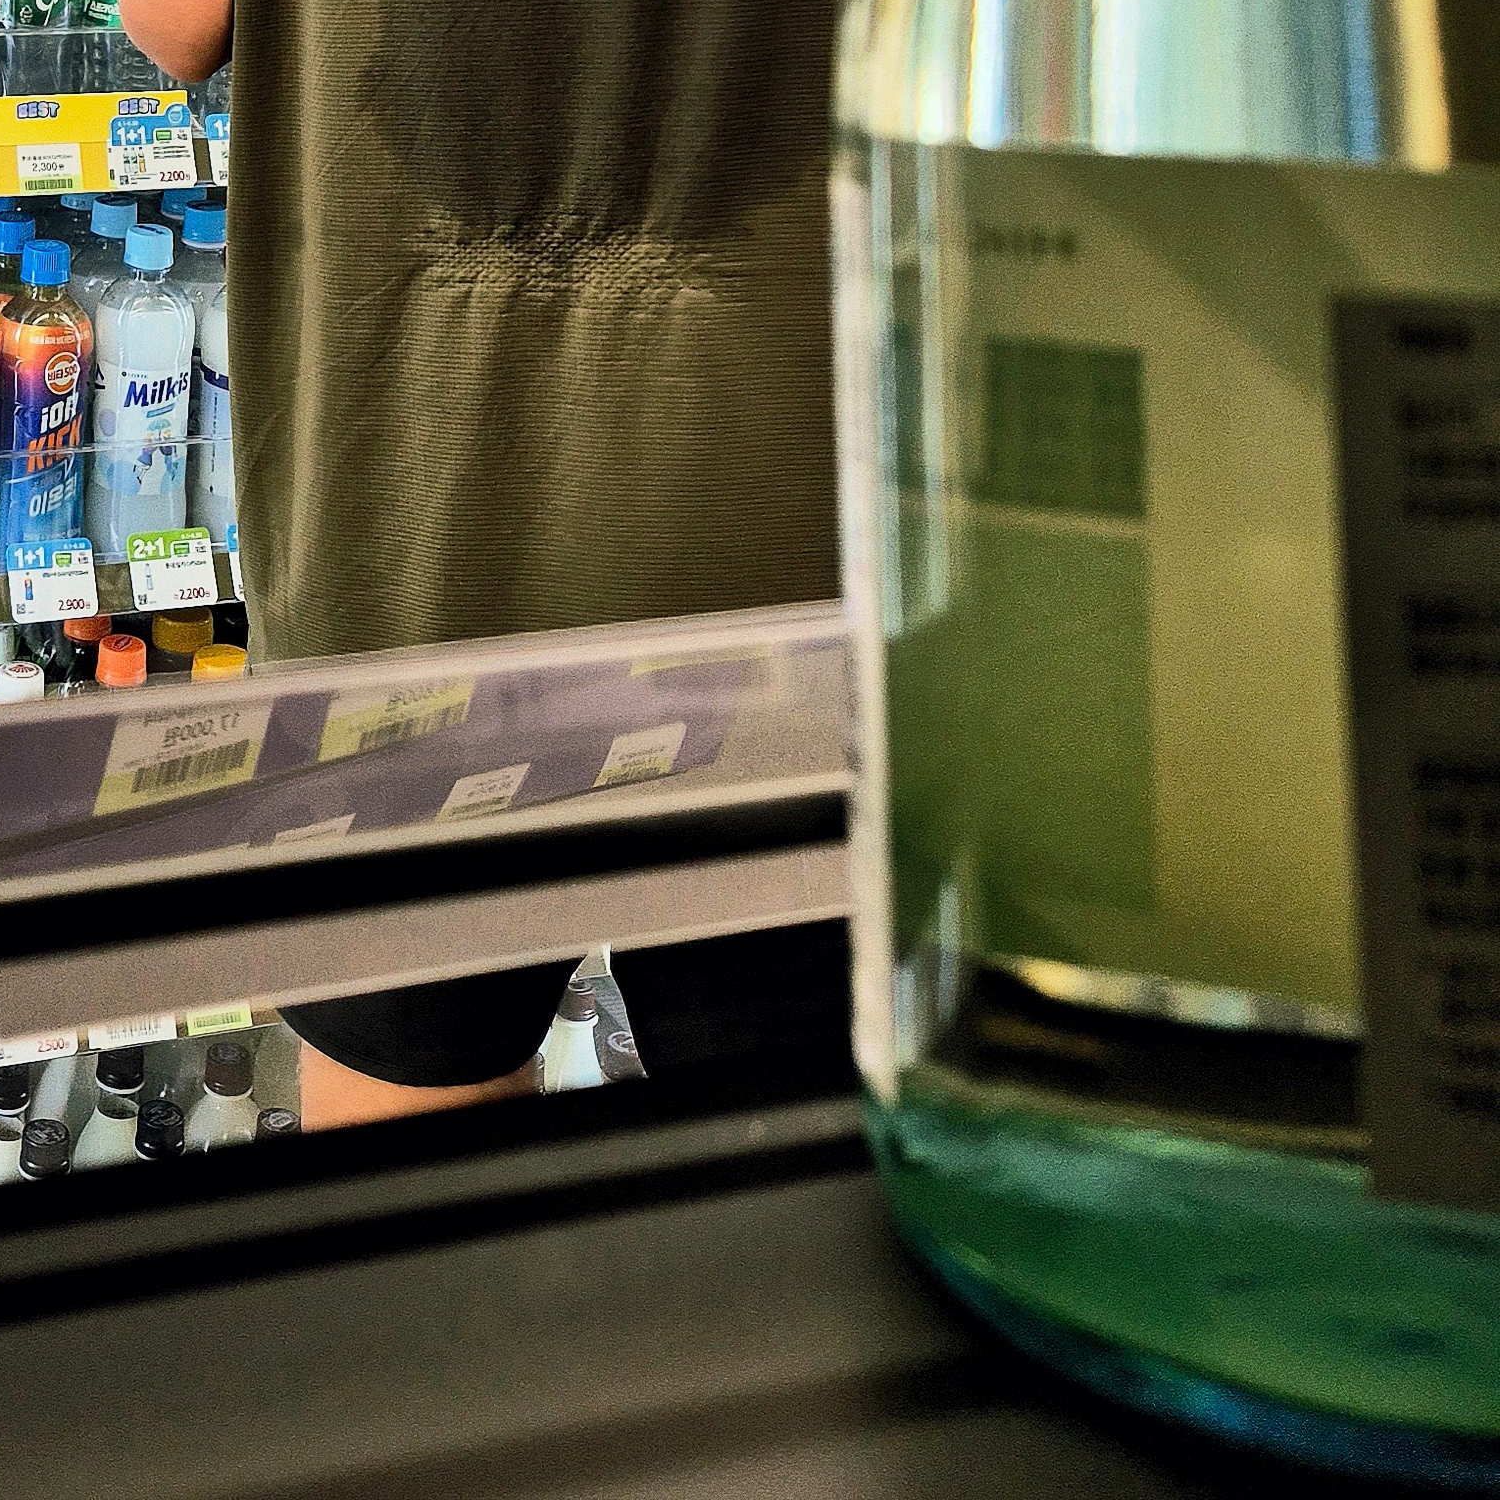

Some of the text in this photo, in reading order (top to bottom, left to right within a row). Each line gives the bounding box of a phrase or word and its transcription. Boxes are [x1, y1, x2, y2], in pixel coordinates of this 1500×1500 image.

[17, 102, 60, 119] BEST
[119, 98, 160, 114] BEST
[116, 128, 148, 145] 1+1
[32, 161, 65, 172] 2,300원
[159, 171, 191, 182] 2,200원
[47, 366, 77, 383] 비타500
[124, 370, 190, 410] Milkis
[13, 547, 46, 567] 1+1
[132, 538, 164, 559] 2+1
[179, 587, 211, 599] 2,200원
[59, 599, 91, 611] 2,900원
